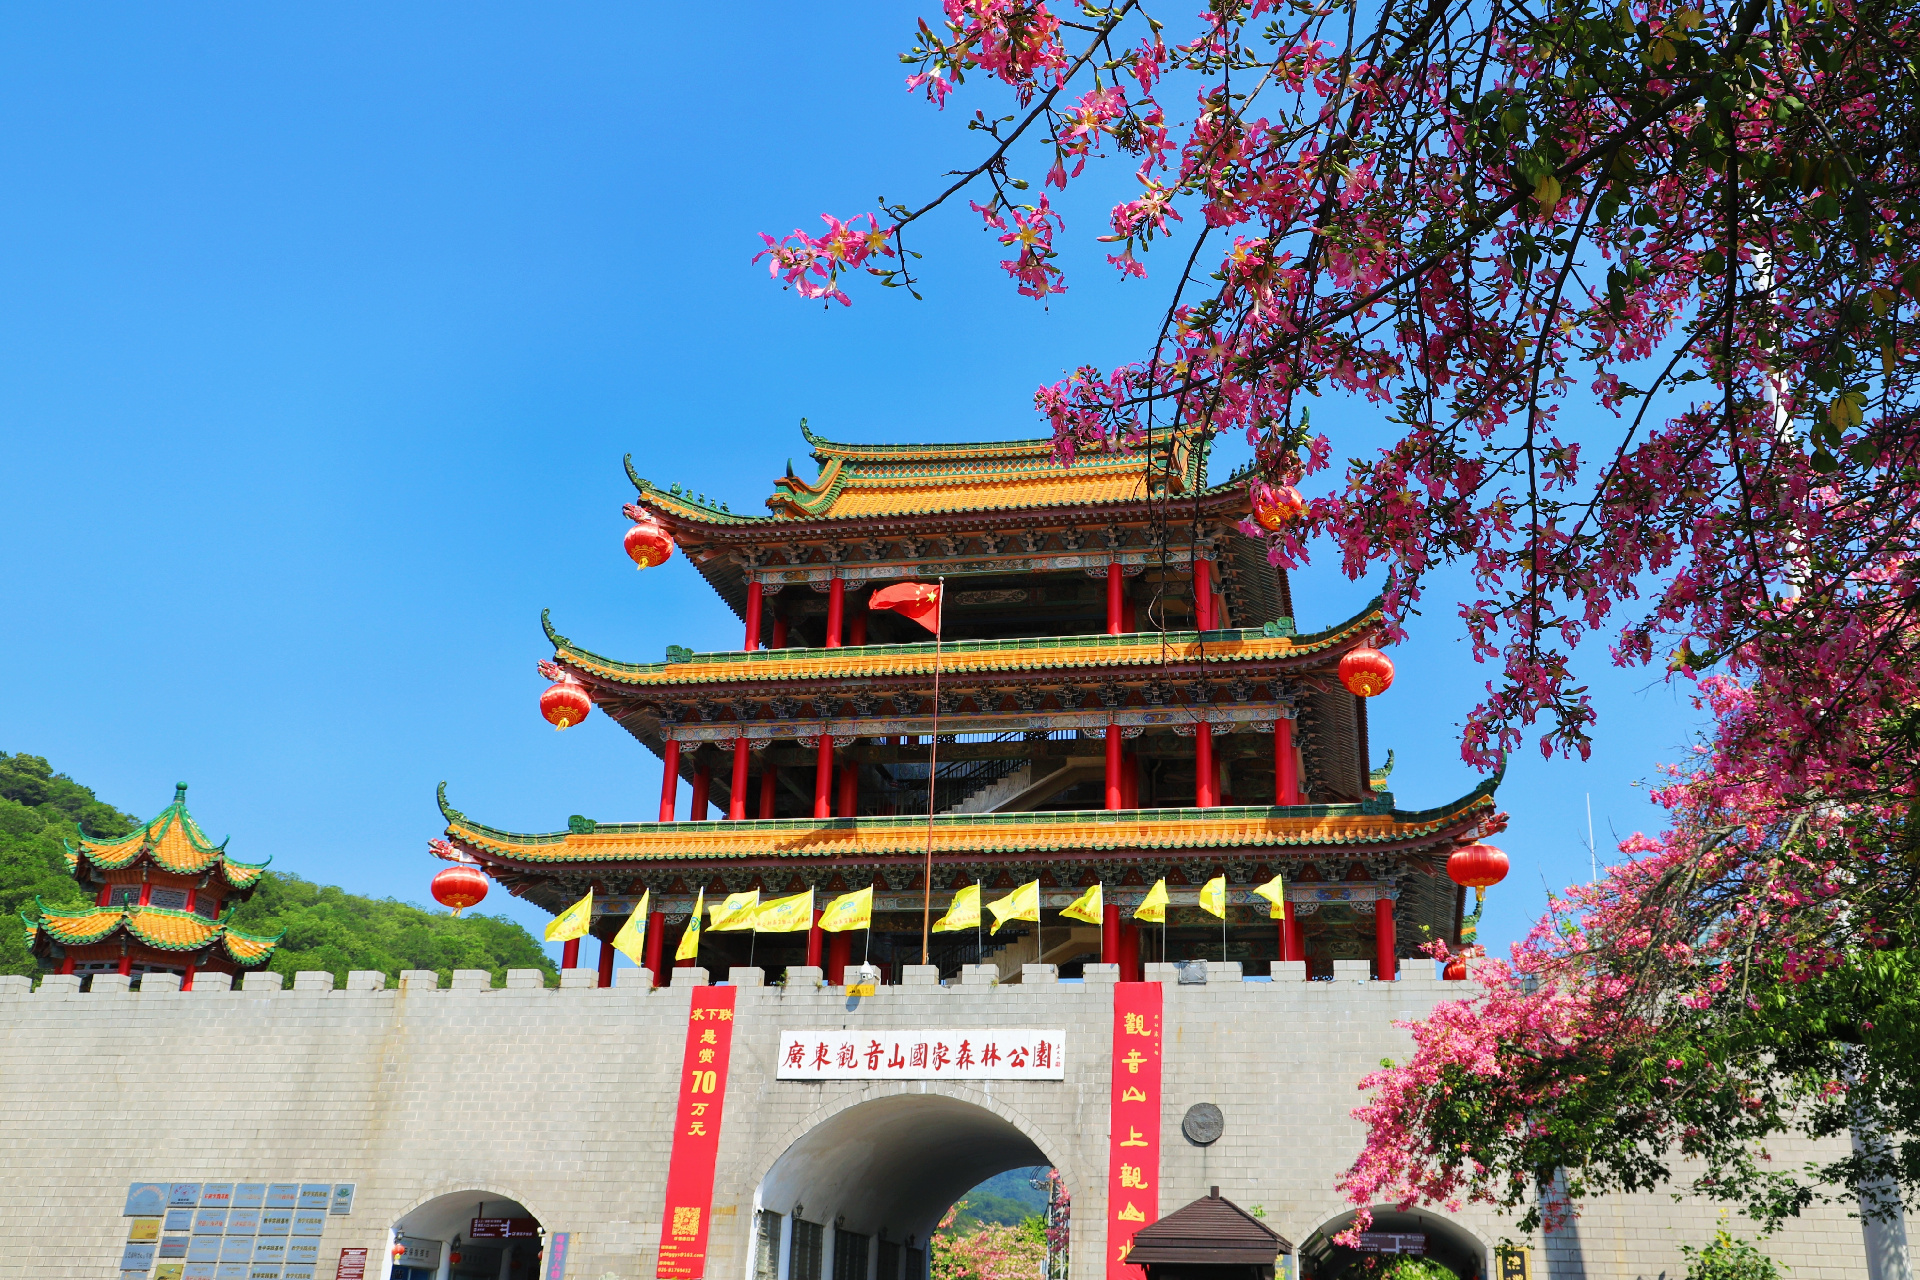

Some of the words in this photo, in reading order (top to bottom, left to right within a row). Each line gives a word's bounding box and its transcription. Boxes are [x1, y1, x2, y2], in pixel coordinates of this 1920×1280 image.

[690, 1008, 734, 1022] 求下联
[782, 1039, 1053, 1072] 廣東觀音山國家森林公園
[688, 1029, 718, 1137] 悬赏70万元
